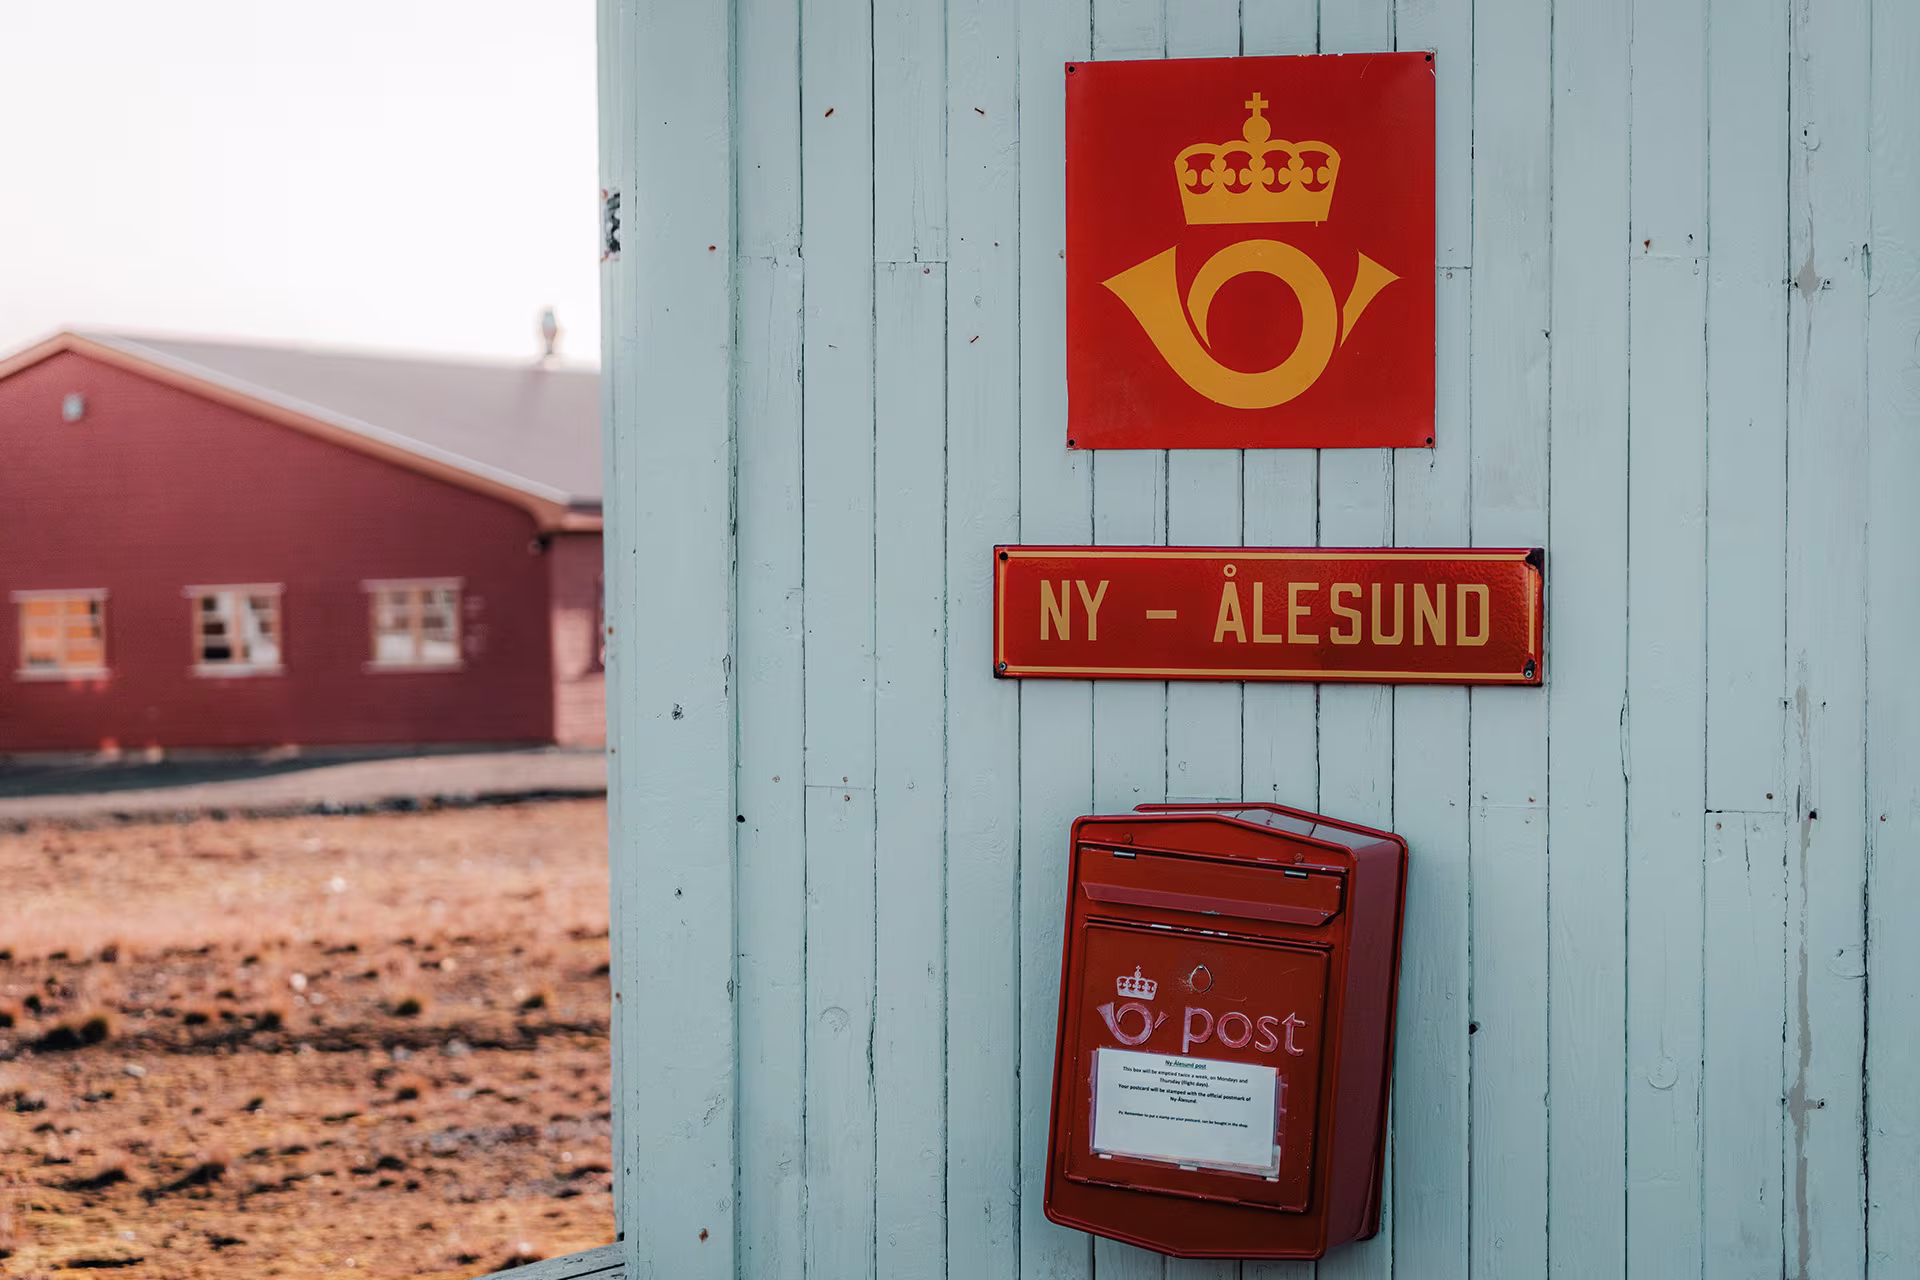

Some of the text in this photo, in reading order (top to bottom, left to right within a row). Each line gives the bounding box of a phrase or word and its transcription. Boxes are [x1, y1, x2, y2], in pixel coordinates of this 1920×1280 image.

[1040, 580, 1109, 641] NY
[1213, 564, 1490, 646] ÅLESUND
[1182, 1006, 1306, 1057] post
